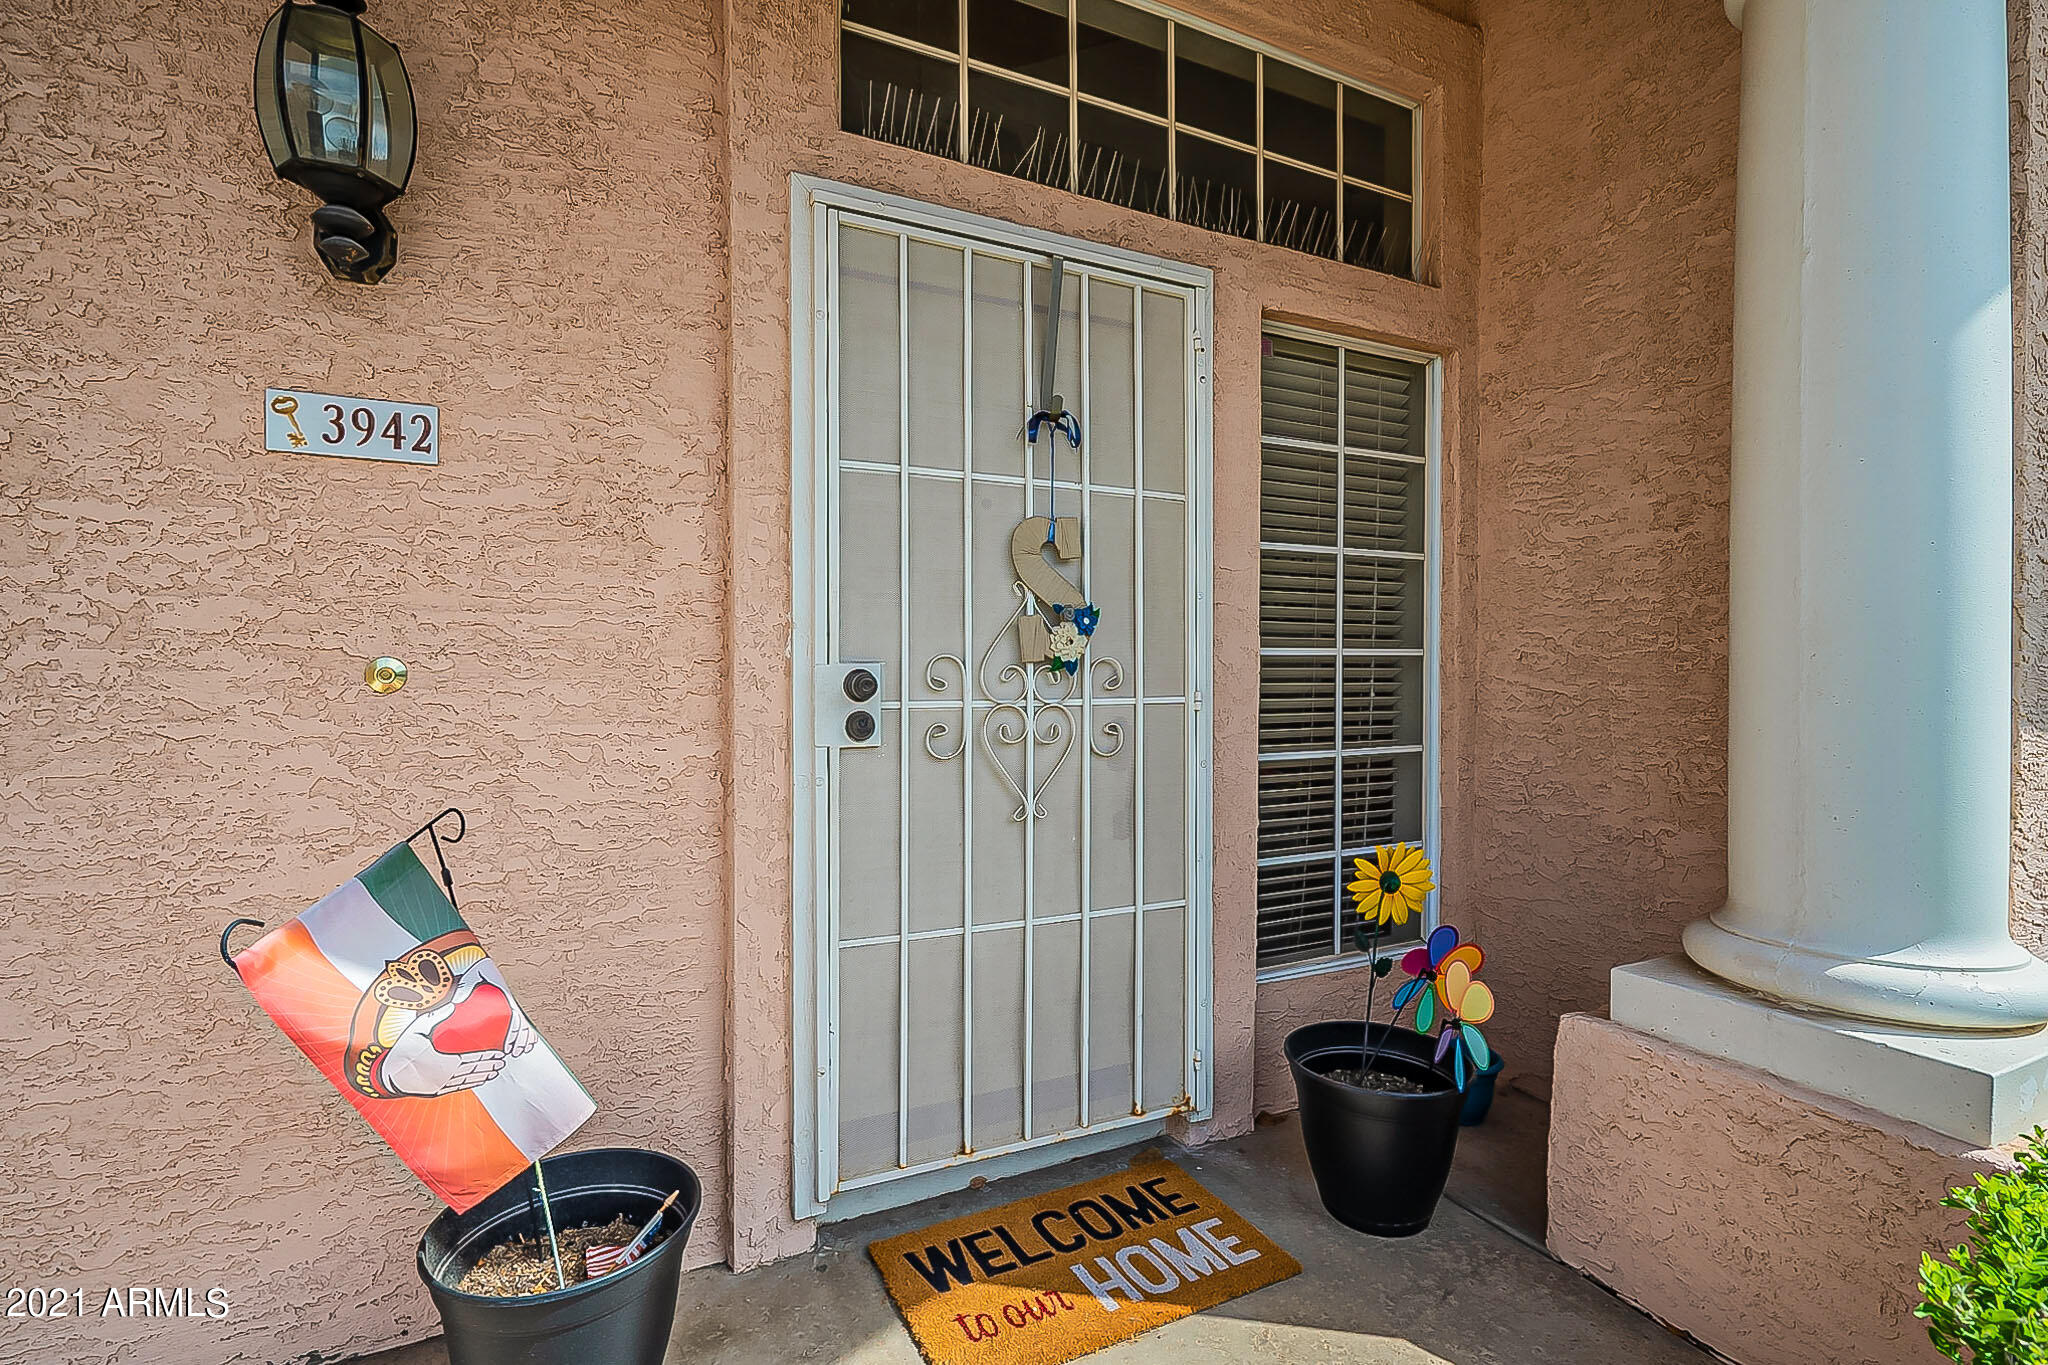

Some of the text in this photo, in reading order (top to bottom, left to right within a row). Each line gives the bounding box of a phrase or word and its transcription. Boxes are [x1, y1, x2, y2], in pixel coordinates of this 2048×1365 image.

[321, 403, 433, 454] 3942
[903, 1177, 1200, 1293] WELCOME
[952, 1217, 1262, 1342] to our HOME
